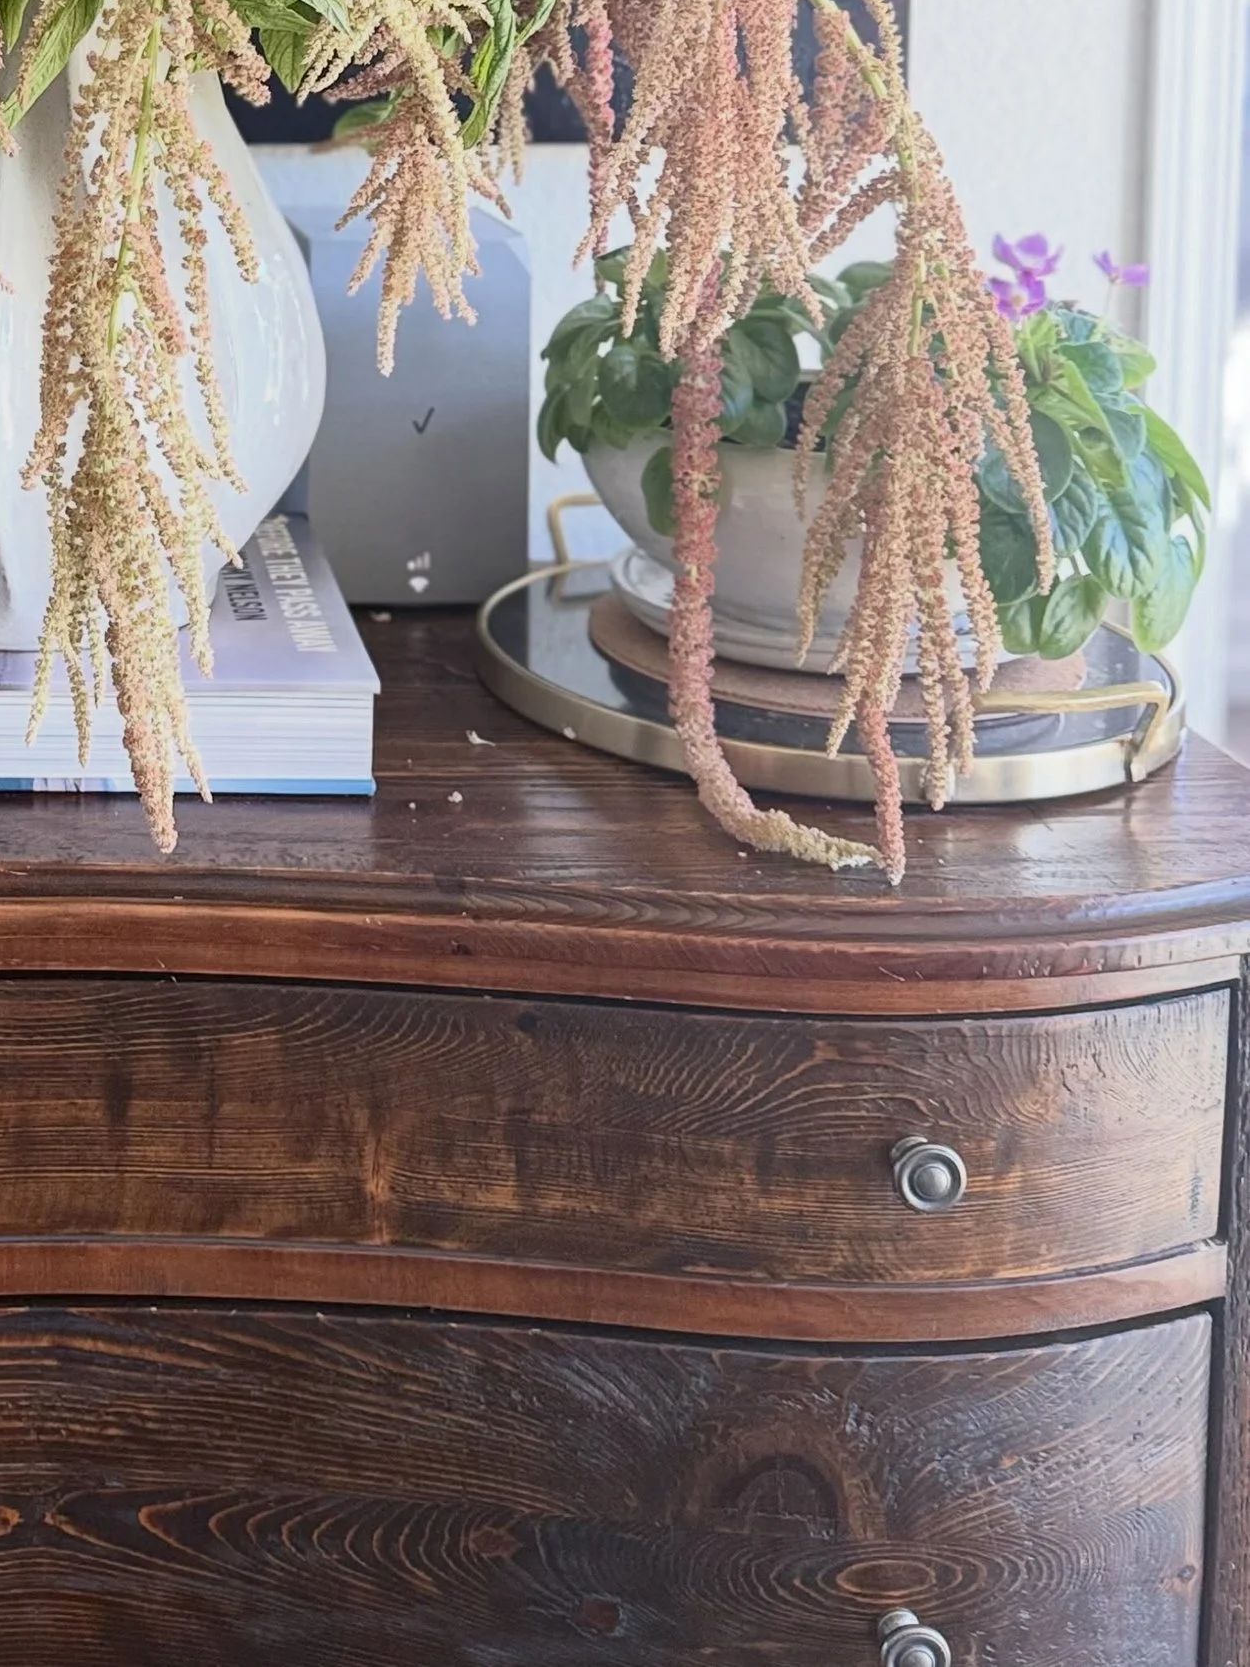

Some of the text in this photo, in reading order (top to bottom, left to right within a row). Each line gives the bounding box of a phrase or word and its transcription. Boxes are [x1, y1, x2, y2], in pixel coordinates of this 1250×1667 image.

[265, 557, 309, 585] THEY
[225, 584, 268, 621] NELSON
[275, 587, 323, 618] PASS
[286, 620, 338, 652] AWAY
